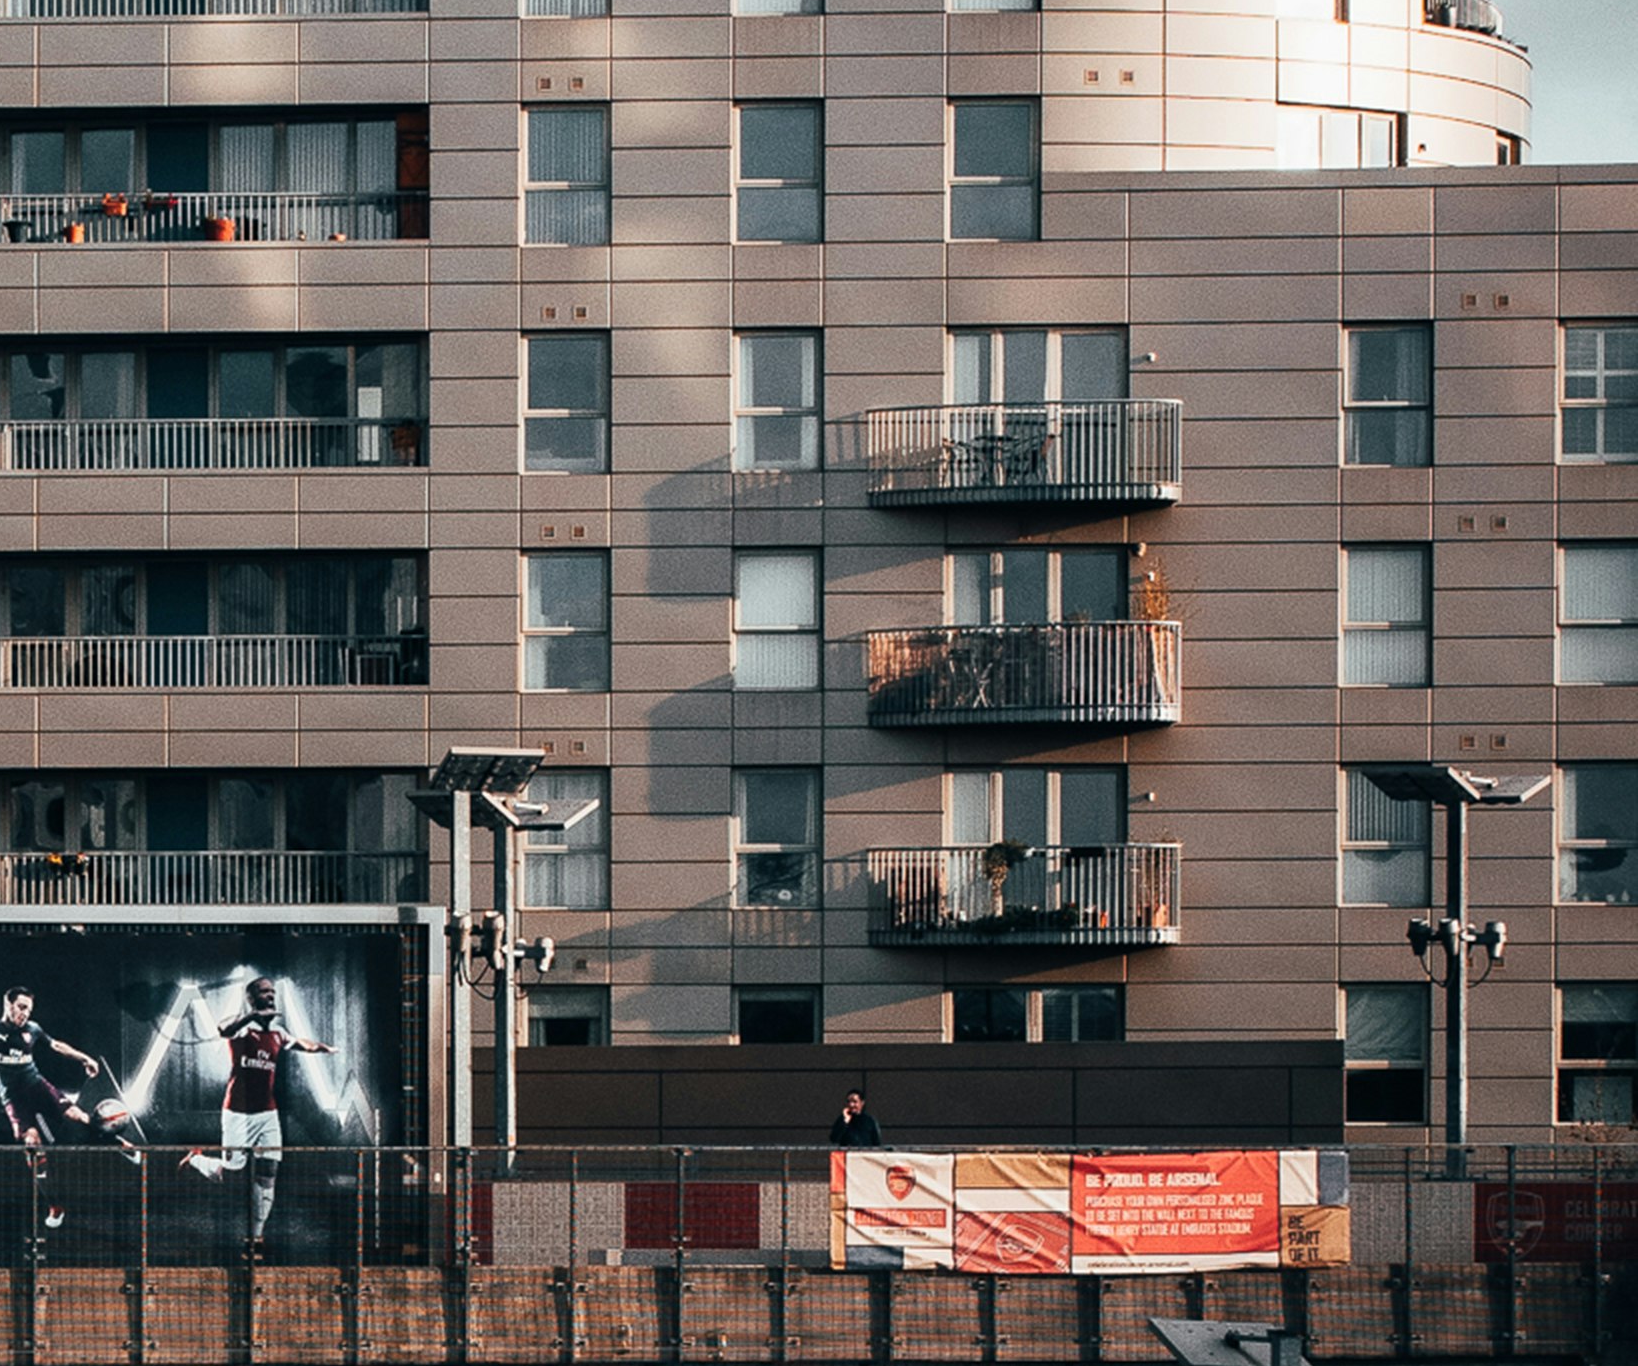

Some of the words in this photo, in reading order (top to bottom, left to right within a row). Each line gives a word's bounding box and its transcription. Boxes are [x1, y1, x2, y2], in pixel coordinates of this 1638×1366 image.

[1085, 1173, 1102, 1188] BE
[1148, 1172, 1164, 1188] BE
[1288, 1215, 1305, 1230] BE
[1288, 1230, 1320, 1245] PART
[1308, 1247, 1319, 1262] IT
